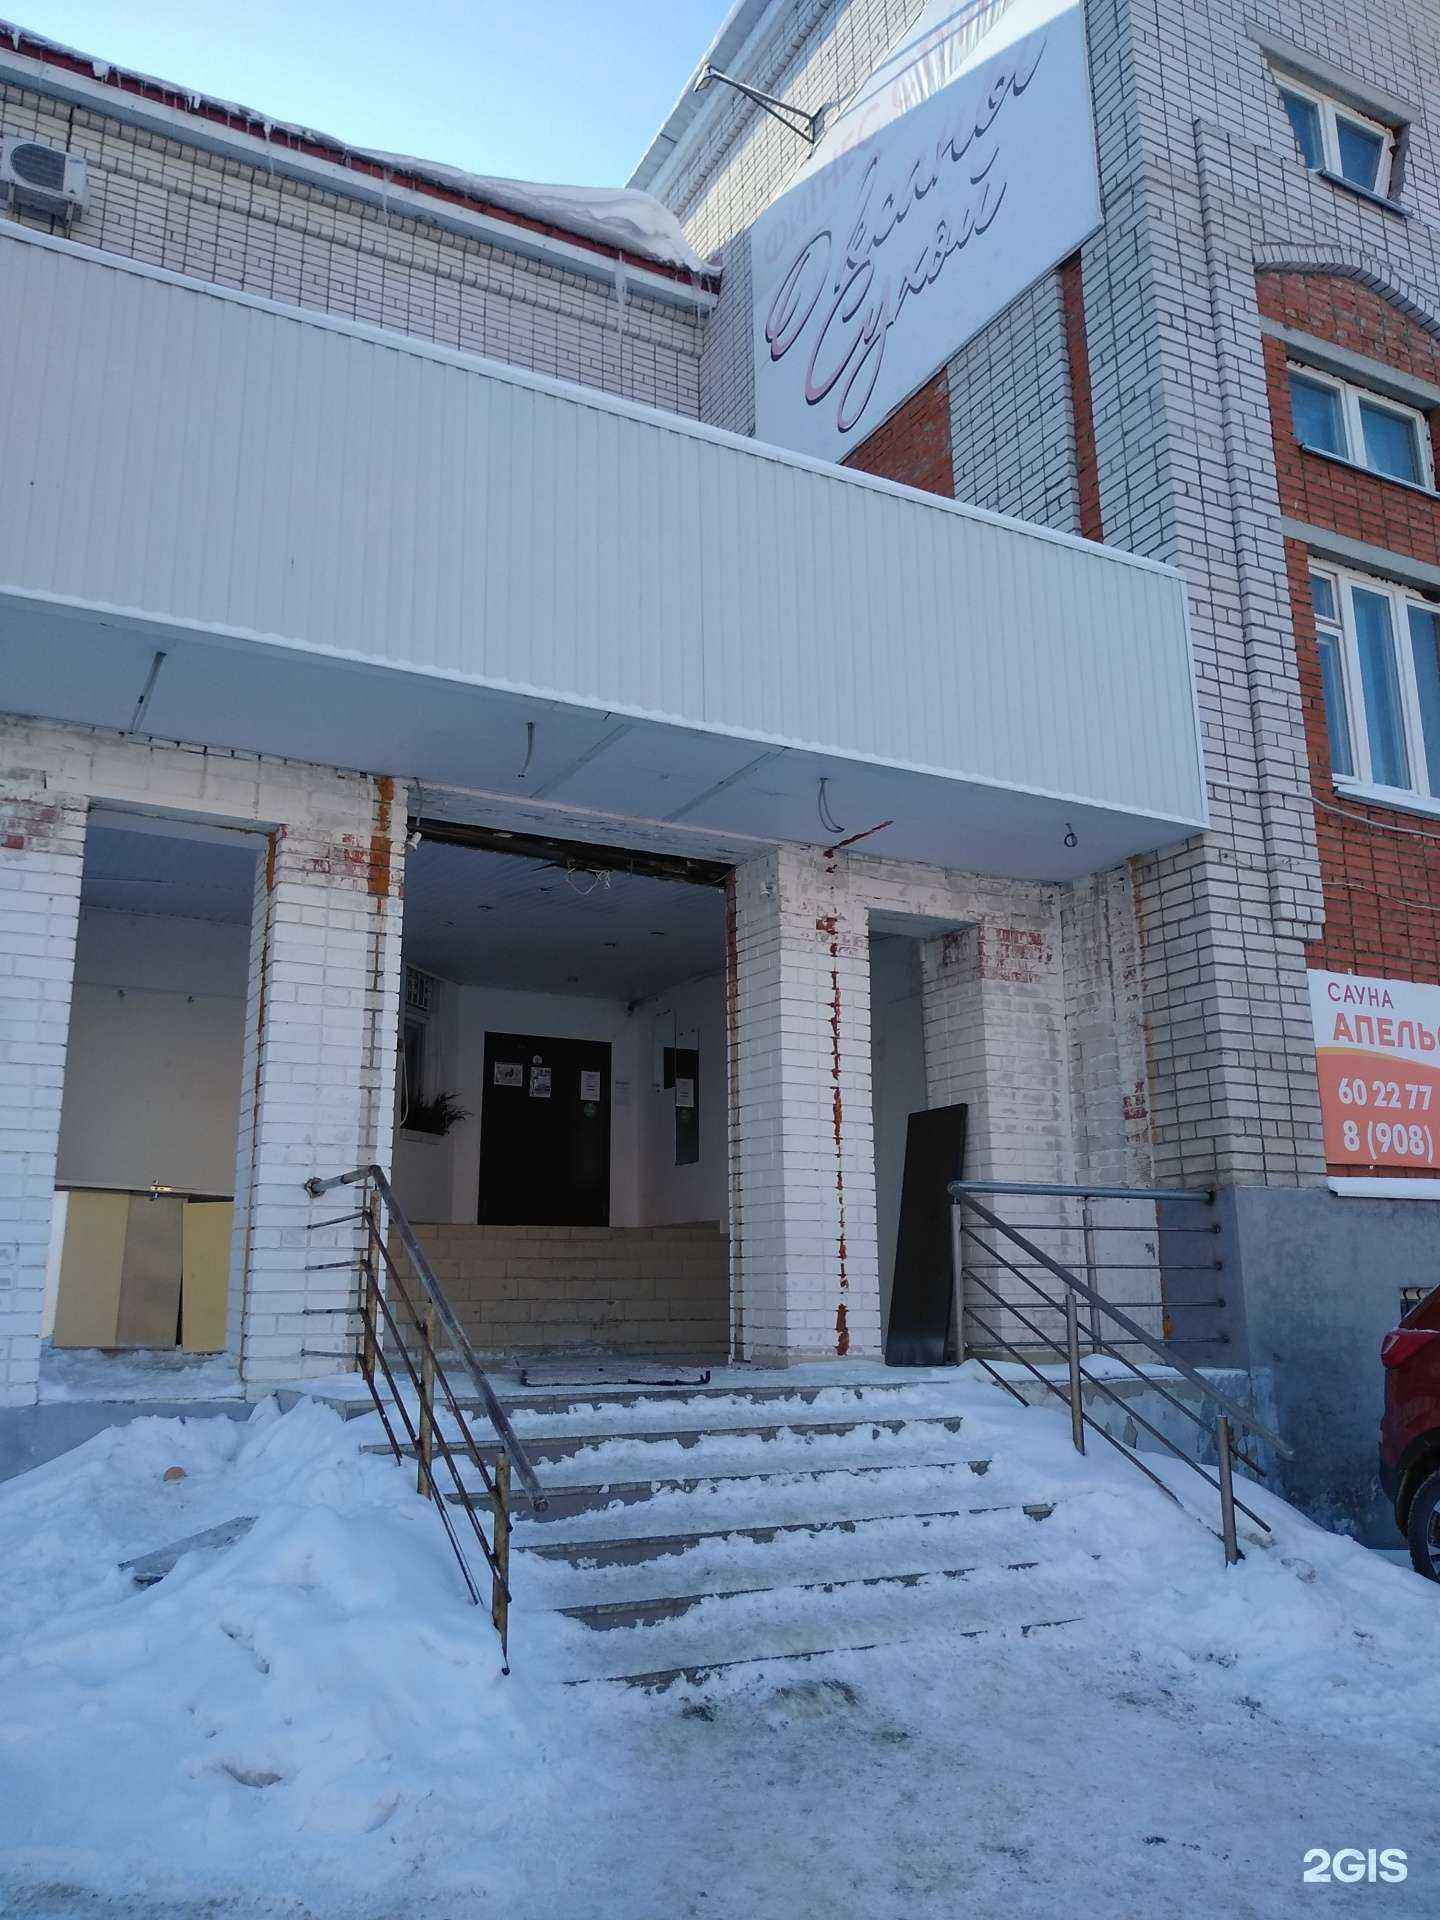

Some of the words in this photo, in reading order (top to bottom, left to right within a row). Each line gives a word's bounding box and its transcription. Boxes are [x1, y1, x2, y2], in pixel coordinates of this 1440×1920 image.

[1327, 981, 1394, 1009] САУНА
[1333, 1012, 1440, 1051] АПЕЛЬ
[1338, 1077, 1368, 1106] 60
[1373, 1080, 1402, 1109] 22
[1405, 1083, 1433, 1111] 77
[1342, 1120, 1361, 1152] 8
[1367, 1121, 1434, 1164] (908)
